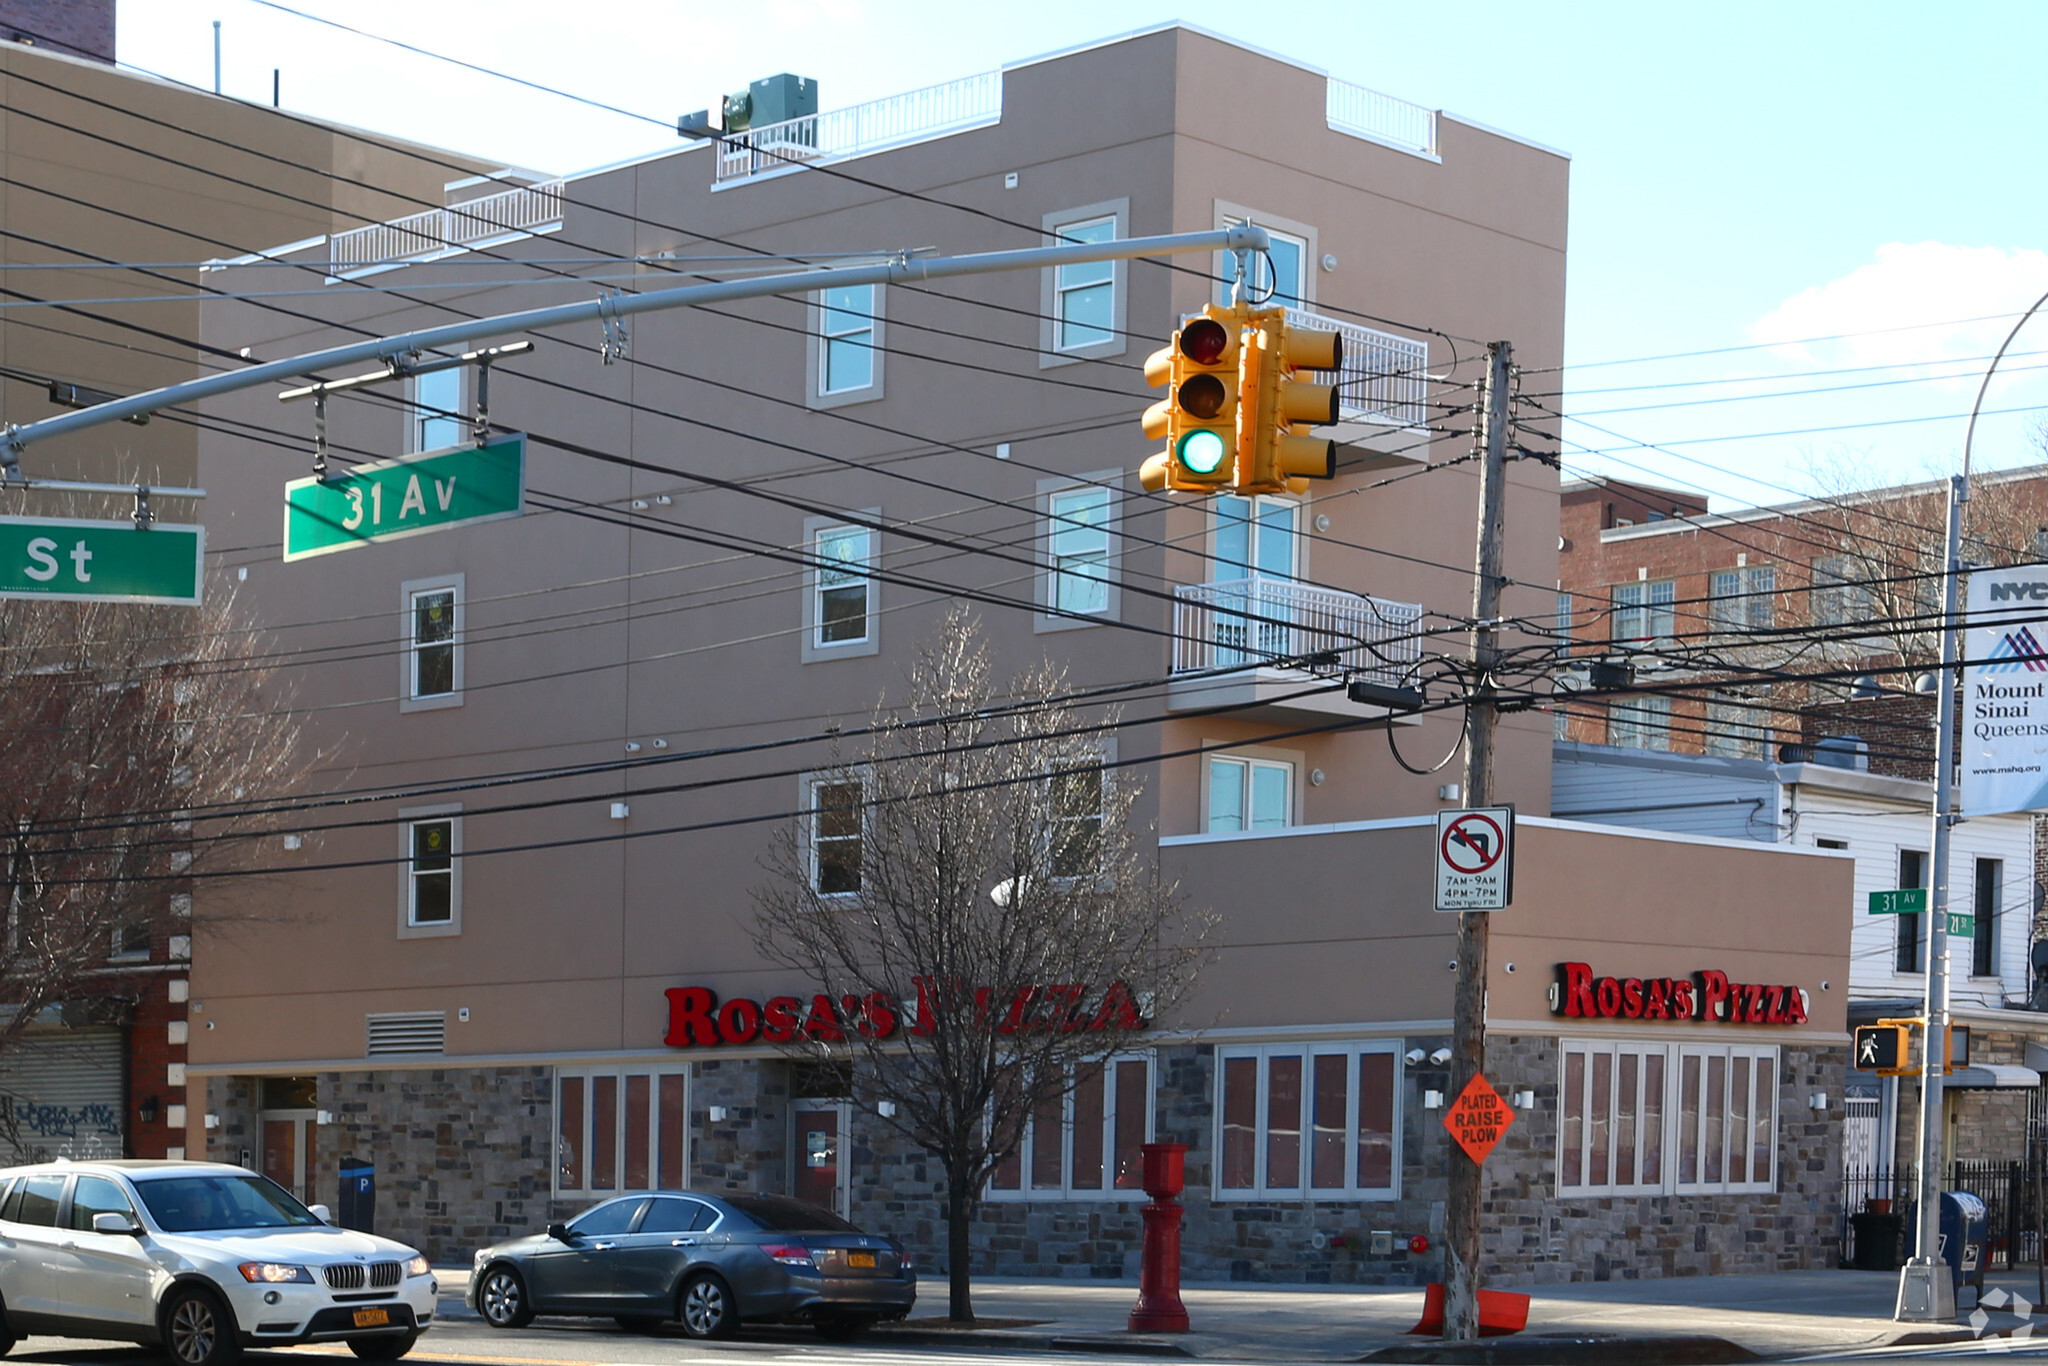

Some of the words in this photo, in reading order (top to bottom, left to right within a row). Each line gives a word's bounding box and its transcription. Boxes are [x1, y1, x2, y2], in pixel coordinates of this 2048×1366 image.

[342, 482, 382, 530] 31
[399, 474, 457, 519] Av
[24, 537, 93, 583] St
[1990, 582, 2048, 601] NYC
[1975, 682, 2045, 700] Mount
[1974, 701, 2029, 719] Sinai
[1973, 722, 2048, 741] Queens
[1972, 764, 2041, 775] www.mshq.org
[1463, 899, 1482, 907] THRU
[1882, 893, 1897, 911] 31
[1950, 915, 1959, 934] 21
[1558, 961, 1694, 1019] ROSA'S
[1698, 969, 1809, 1024] PIZZA
[1461, 1094, 1498, 1111] PLATED
[1454, 1110, 1504, 1128] RAISE
[1461, 1127, 1498, 1145] PLOW
[360, 1177, 369, 1192] P
